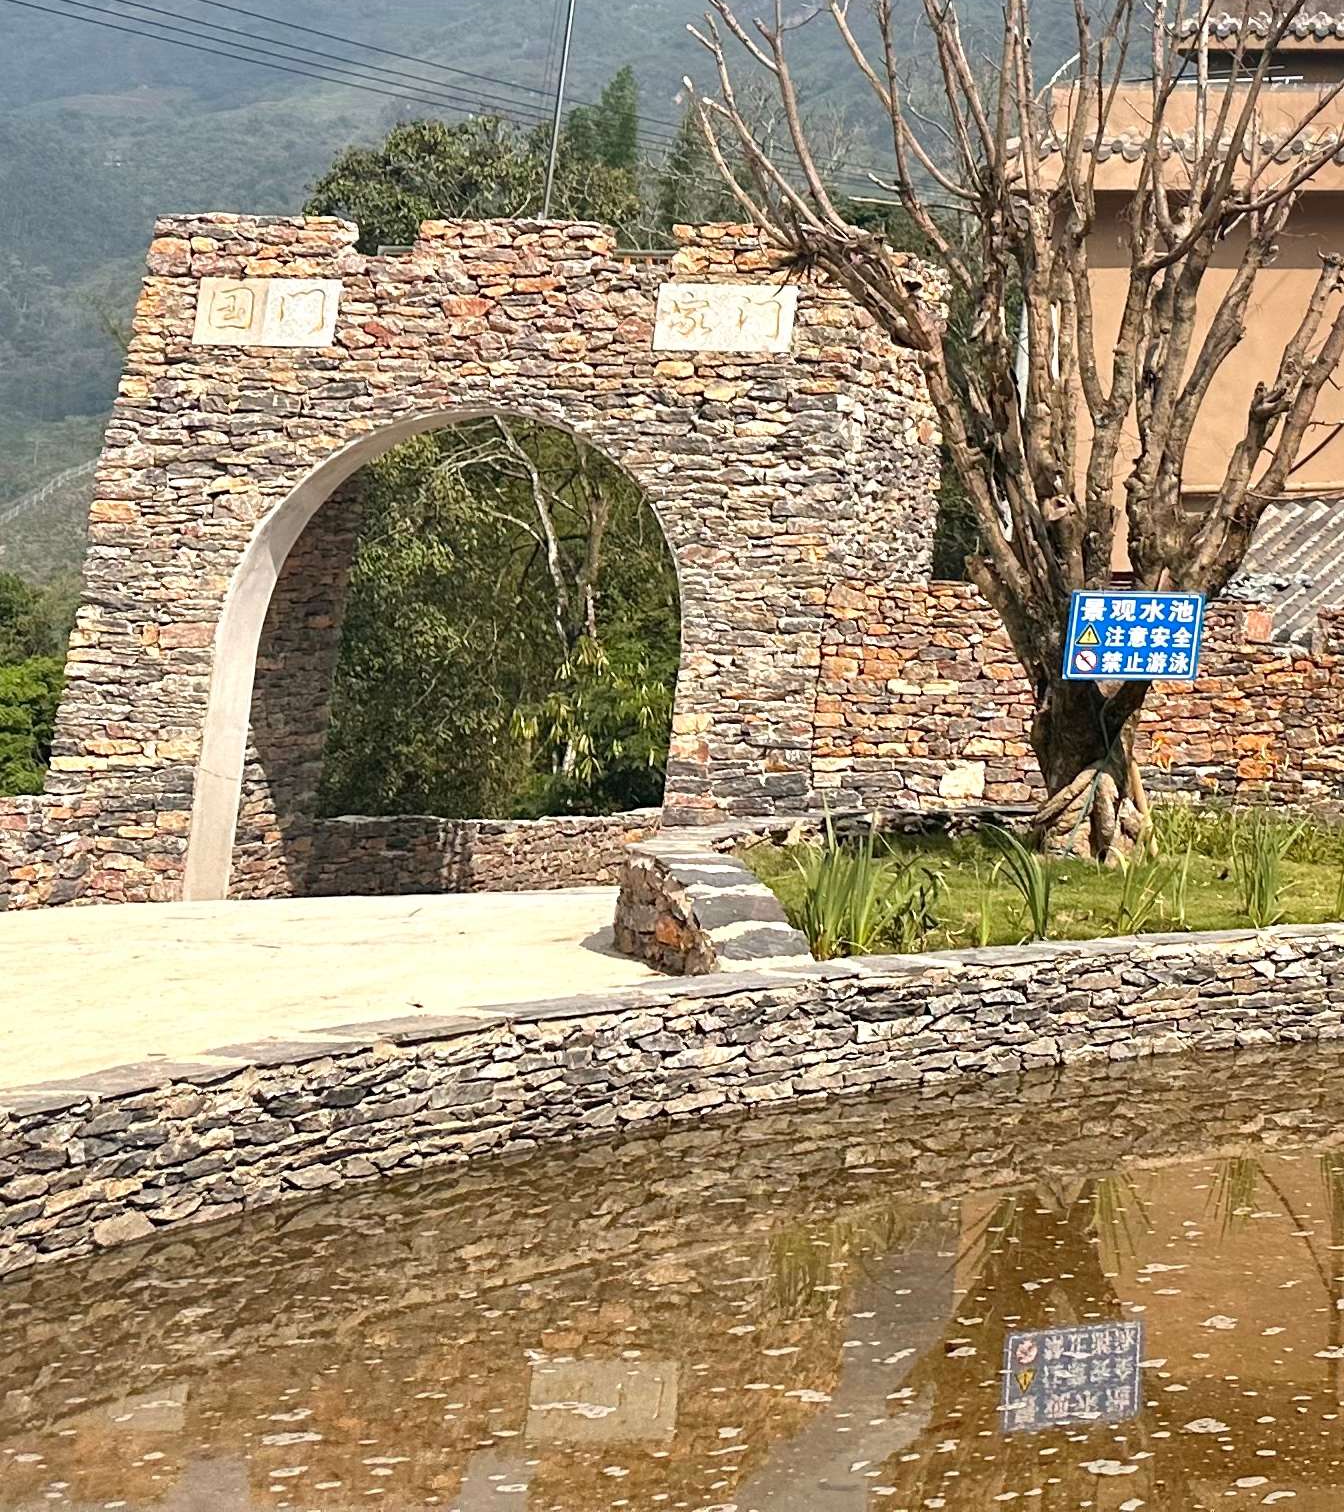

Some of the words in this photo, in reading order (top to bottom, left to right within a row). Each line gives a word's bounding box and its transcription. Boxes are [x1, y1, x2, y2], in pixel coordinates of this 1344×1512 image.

[208, 287, 326, 335] 国门
[1080, 598, 1194, 623] 景观水池
[1104, 625, 1193, 648] 注意安全
[1101, 650, 1189, 673] 禁止游泳
